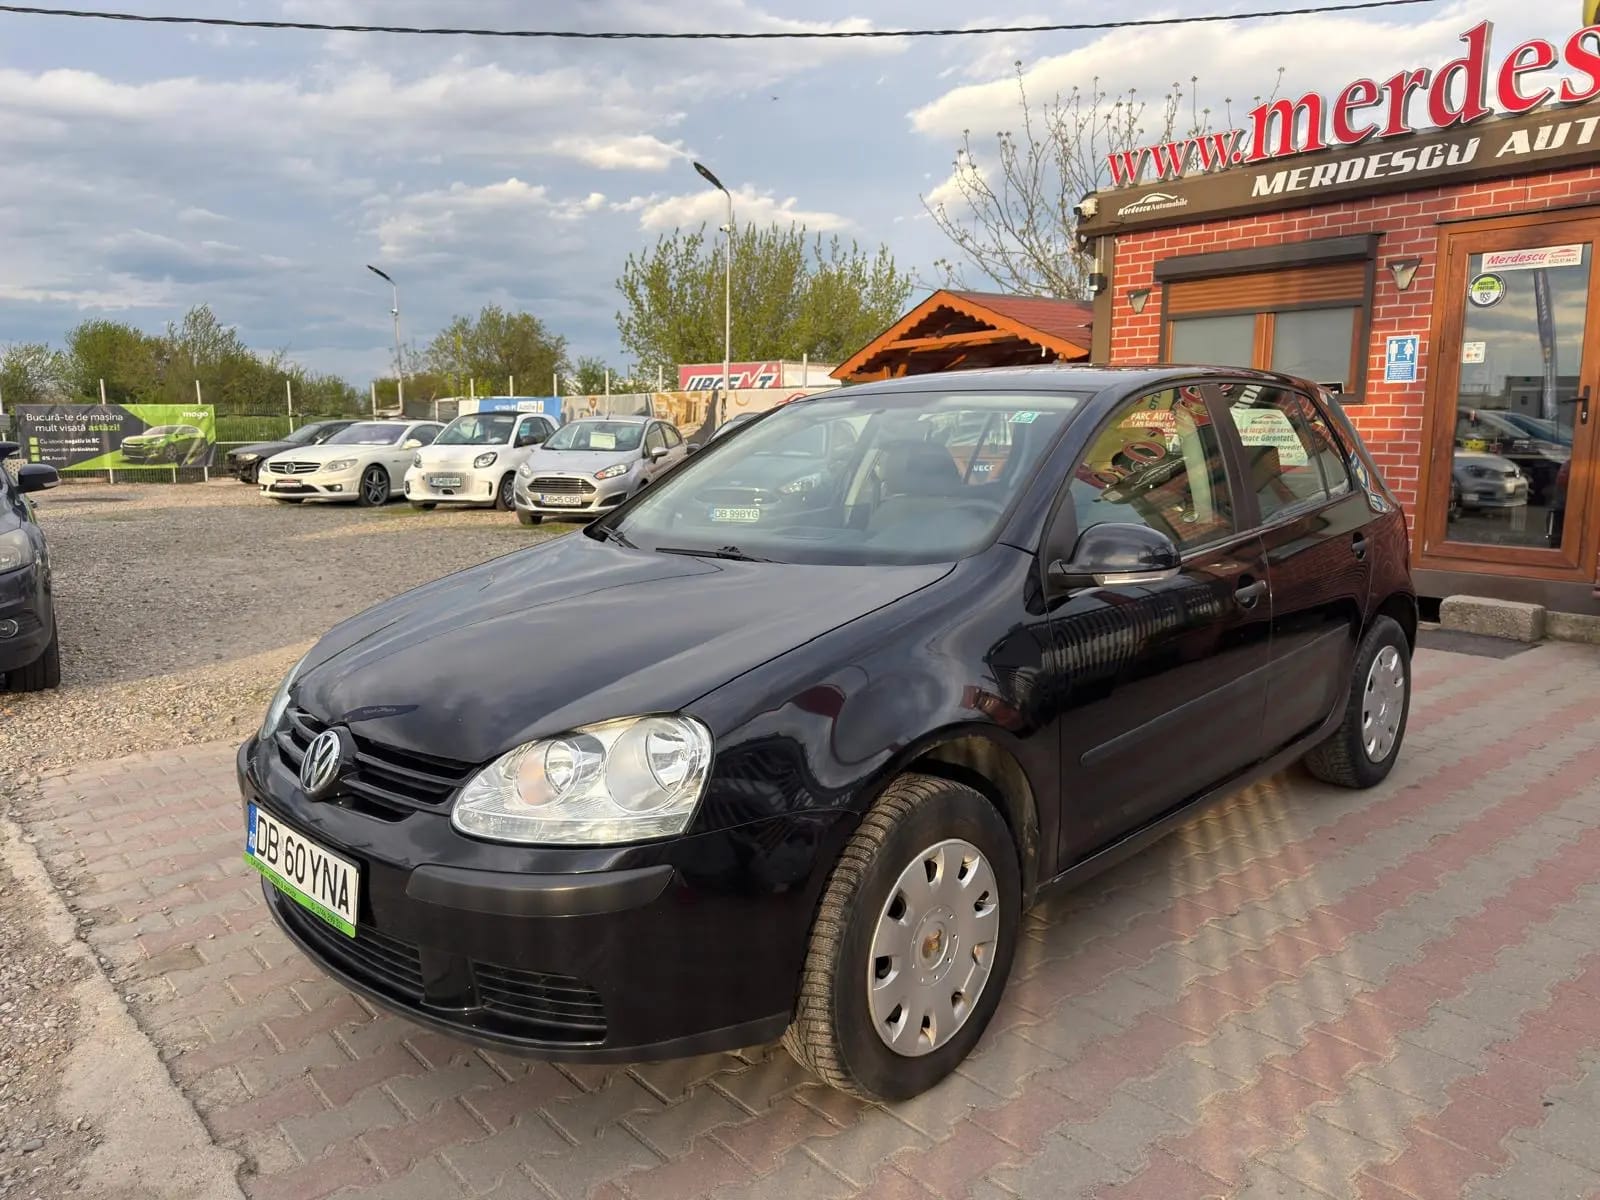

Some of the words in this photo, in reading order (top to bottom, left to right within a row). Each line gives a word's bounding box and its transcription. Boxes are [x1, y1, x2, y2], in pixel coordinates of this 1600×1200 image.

[1252, 138, 1480, 198] MERDESCU
[1487, 253, 1547, 265] Merdescu
[26, 412, 74, 422] Bucură-te
[76, 412, 88, 421] de
[183, 410, 209, 420] mogo
[1131, 412, 1152, 420] PARC
[35, 423, 58, 432] mult
[59, 423, 86, 432] visată
[256, 814, 279, 865] DB
[284, 836, 306, 885] 60
[310, 849, 350, 915] YNA
